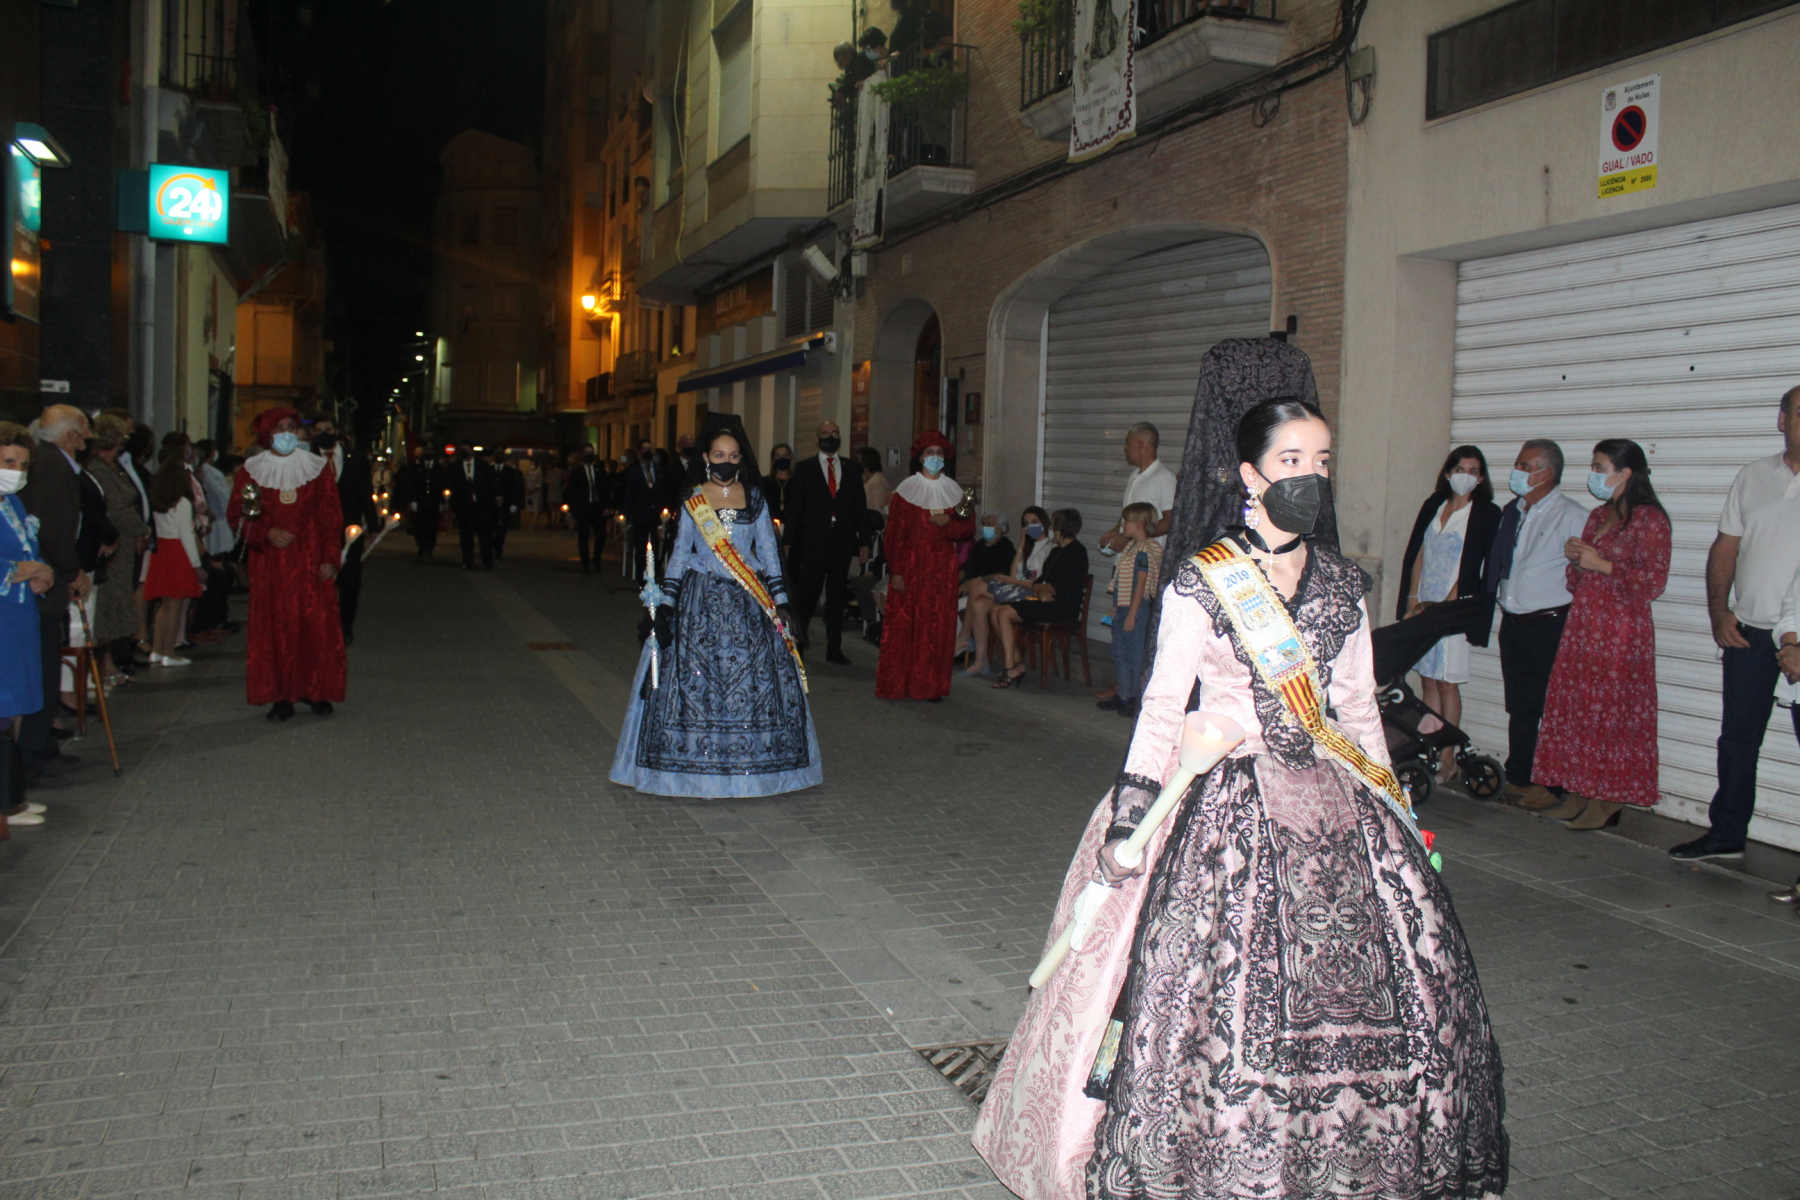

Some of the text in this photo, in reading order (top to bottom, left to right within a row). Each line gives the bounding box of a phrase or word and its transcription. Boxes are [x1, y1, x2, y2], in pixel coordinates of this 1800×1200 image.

[1624, 79, 1654, 94] Ajuntament
[1635, 91, 1650, 102] Nules
[1602, 160, 1625, 173] GUAL
[1630, 151, 1654, 167] VADO
[1601, 185, 1625, 196] LICENCIA
[162, 217, 215, 228] CAJERO ATM
[1223, 569, 1251, 589] 2019
